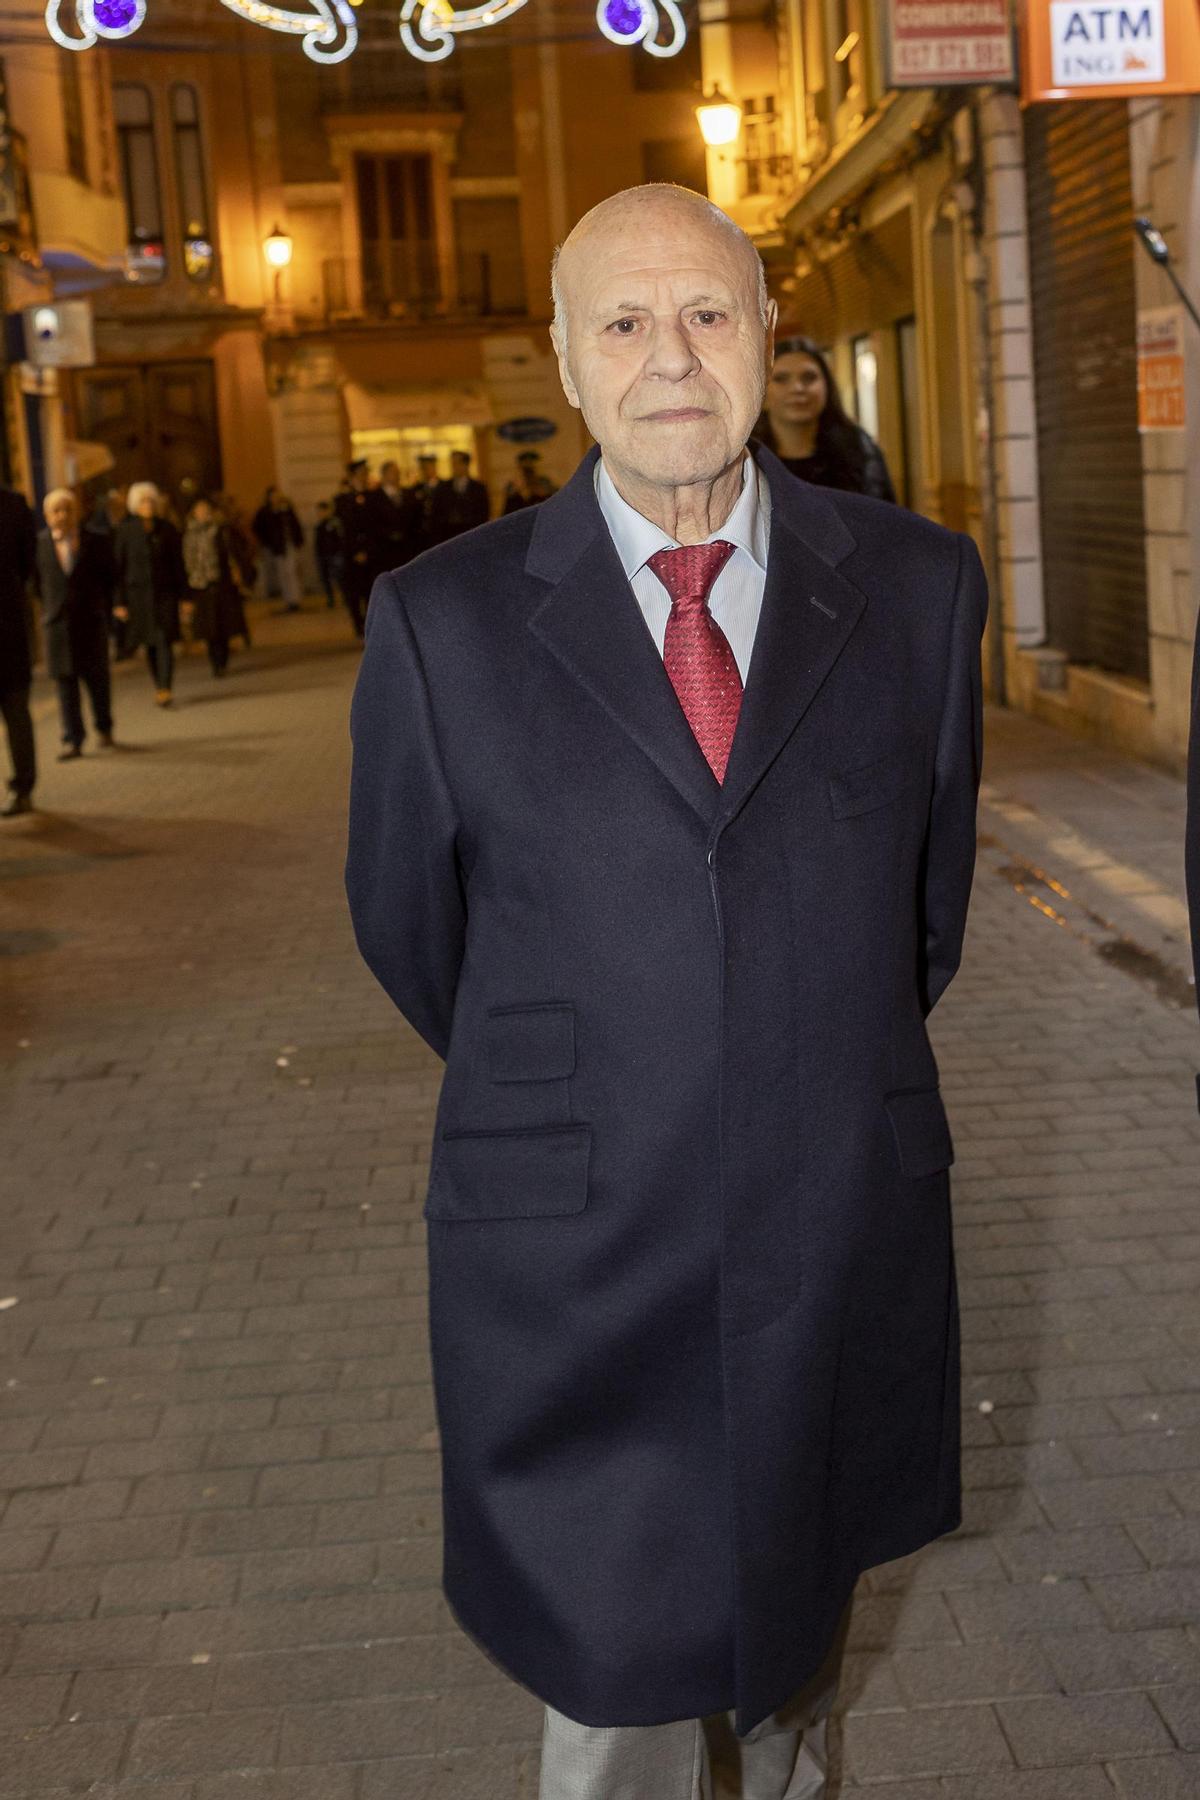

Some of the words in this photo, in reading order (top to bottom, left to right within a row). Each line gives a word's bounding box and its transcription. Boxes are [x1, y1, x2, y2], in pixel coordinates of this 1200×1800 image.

[898, 4, 1005, 27] COMERCIAL
[1063, 8, 1152, 42] ATM
[1063, 52, 1115, 76] ING
